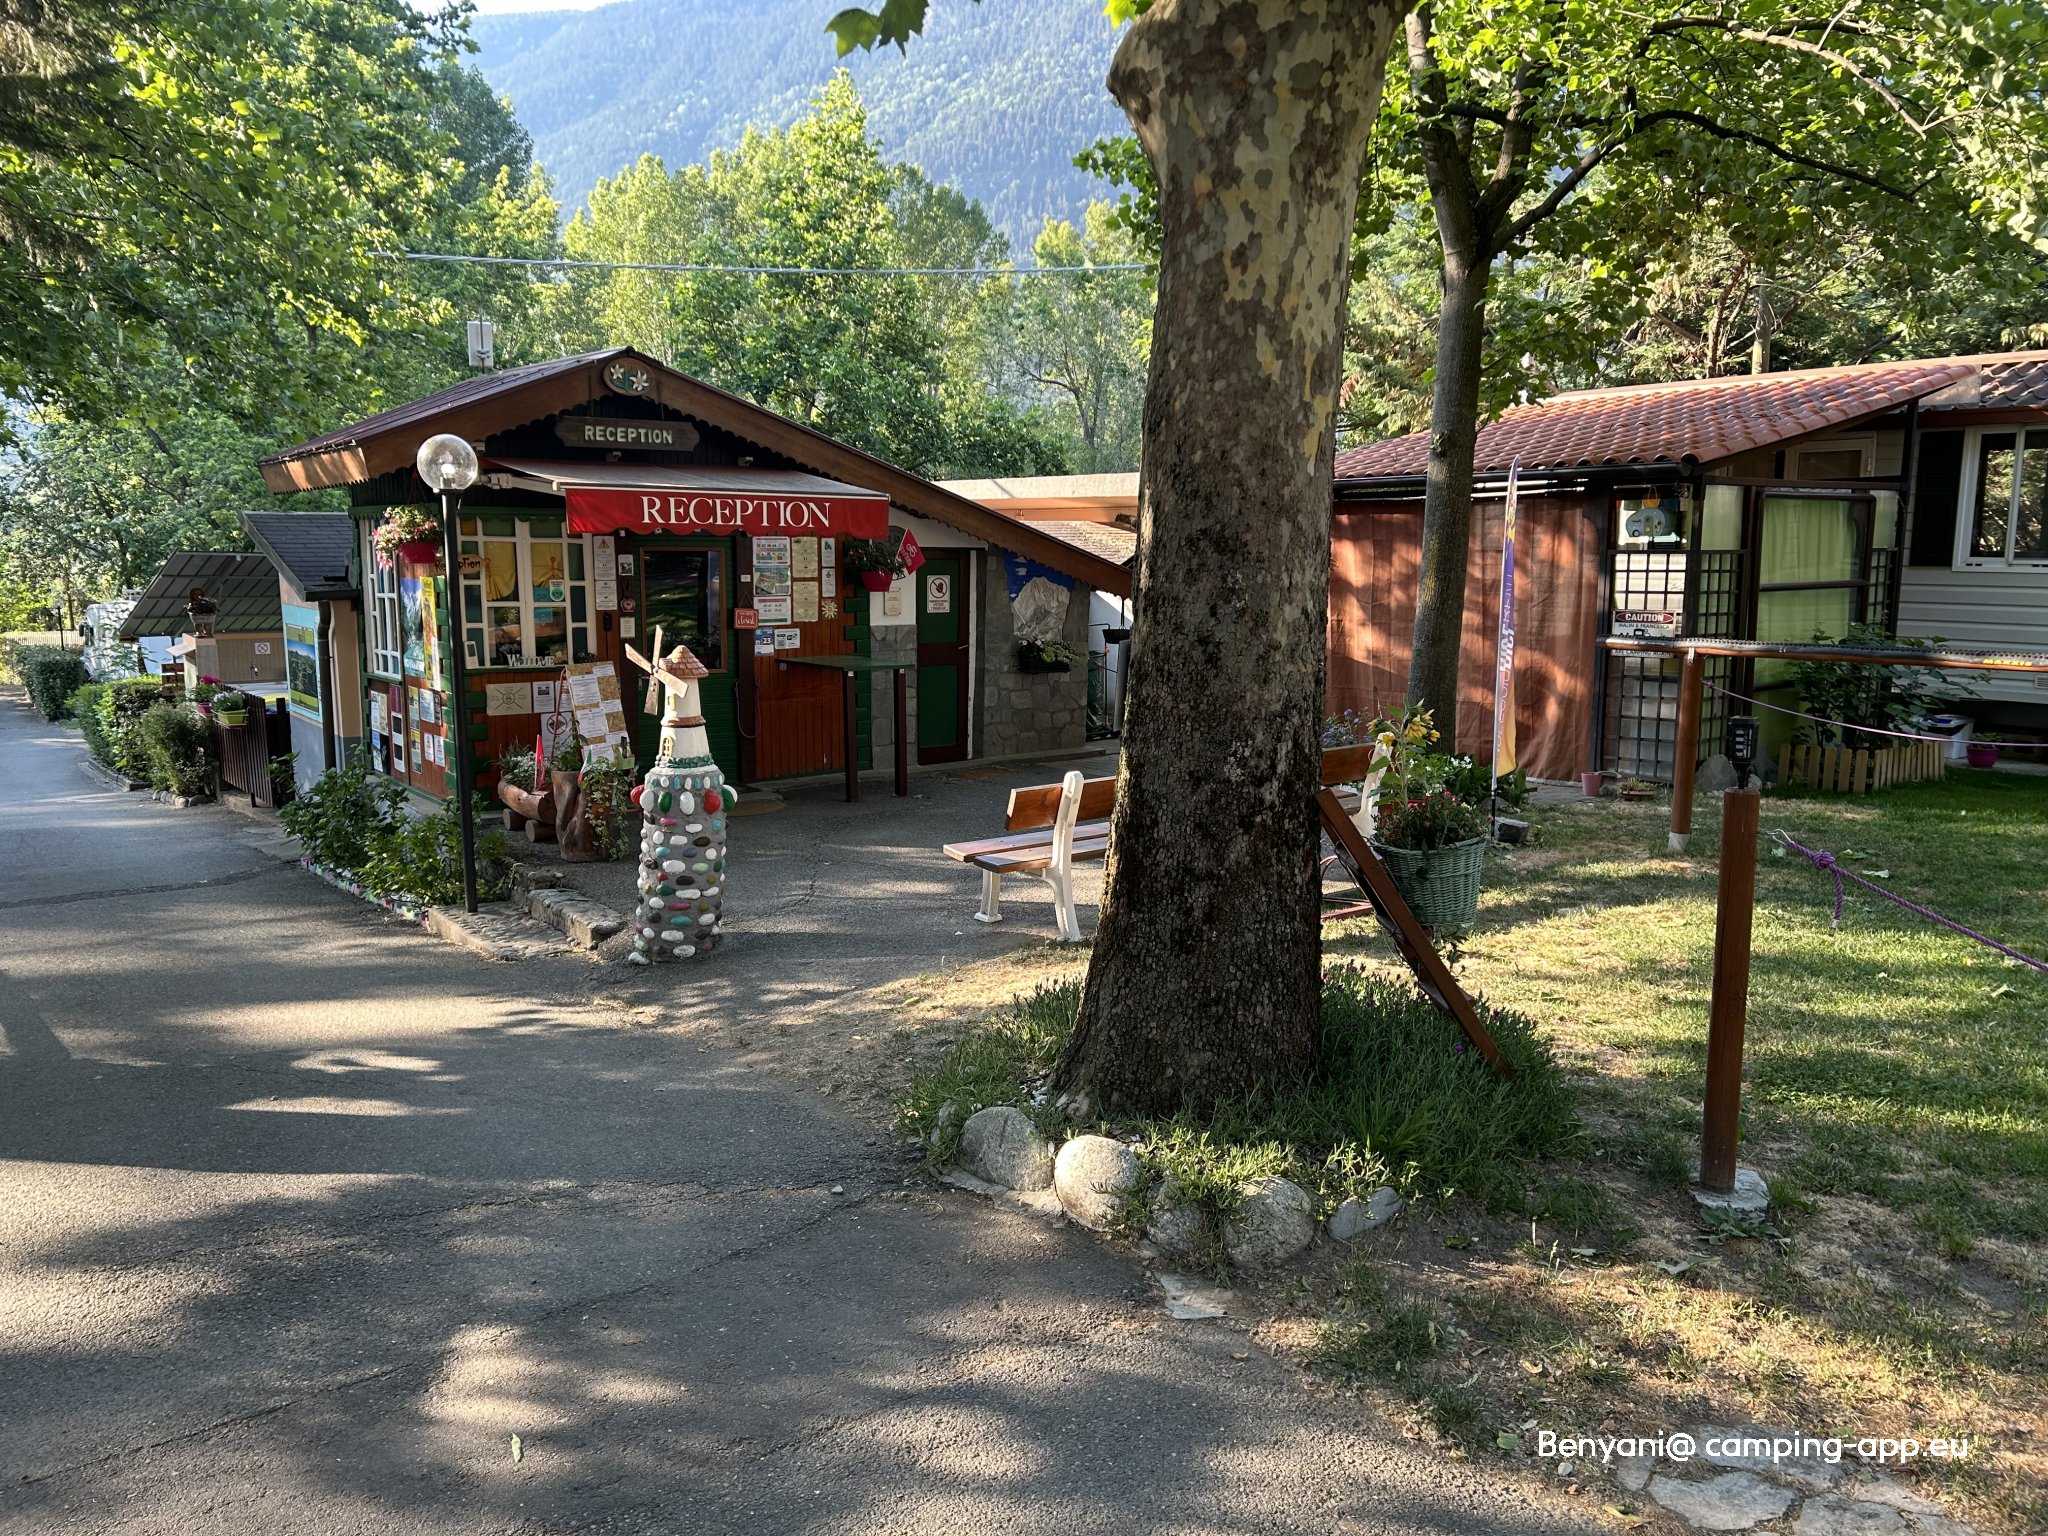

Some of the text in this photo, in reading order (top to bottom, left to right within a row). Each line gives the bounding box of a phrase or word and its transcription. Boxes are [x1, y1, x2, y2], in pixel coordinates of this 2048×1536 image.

[584, 425, 673, 444] RECEPTION
[640, 496, 831, 528] RECEPTION
[1625, 613, 1664, 622] CAUTION
[506, 653, 555, 668] WELCOME
